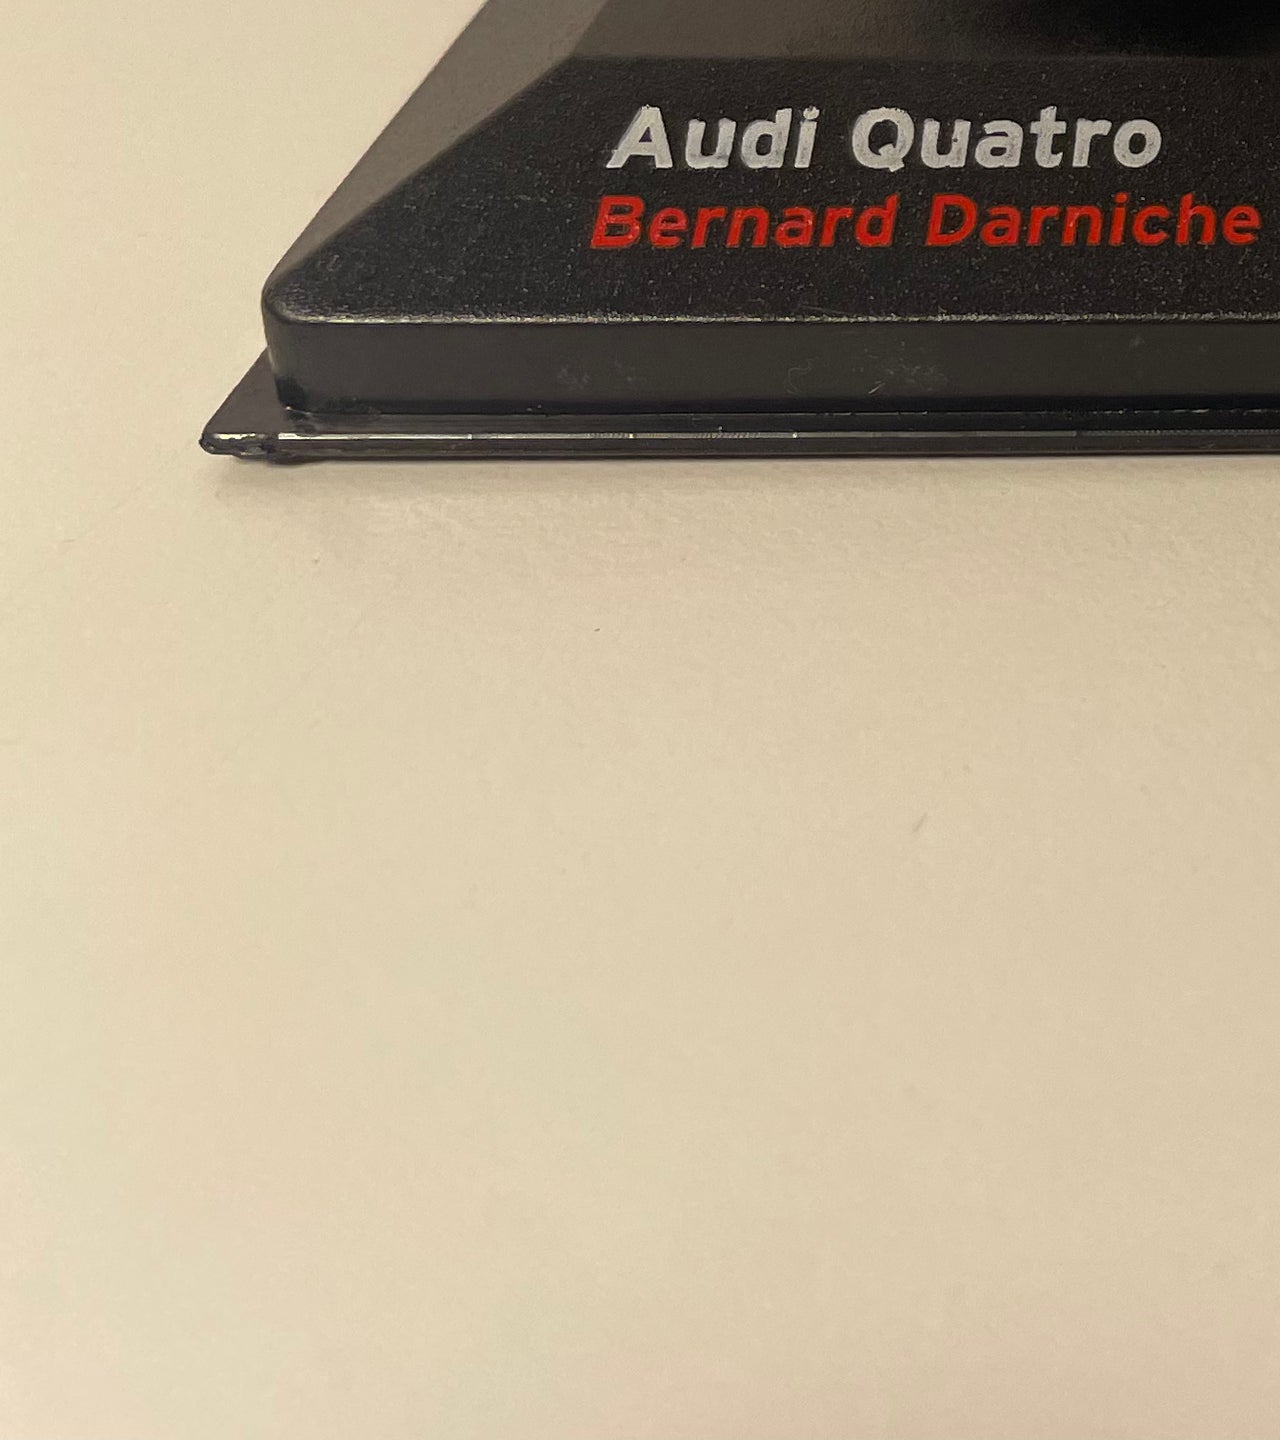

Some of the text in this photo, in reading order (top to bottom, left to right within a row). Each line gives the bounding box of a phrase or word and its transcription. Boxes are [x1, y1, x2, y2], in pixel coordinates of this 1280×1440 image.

[606, 104, 1162, 172] Audi Quatro
[590, 193, 899, 249] Bernard
[925, 191, 1262, 247] Darniche
